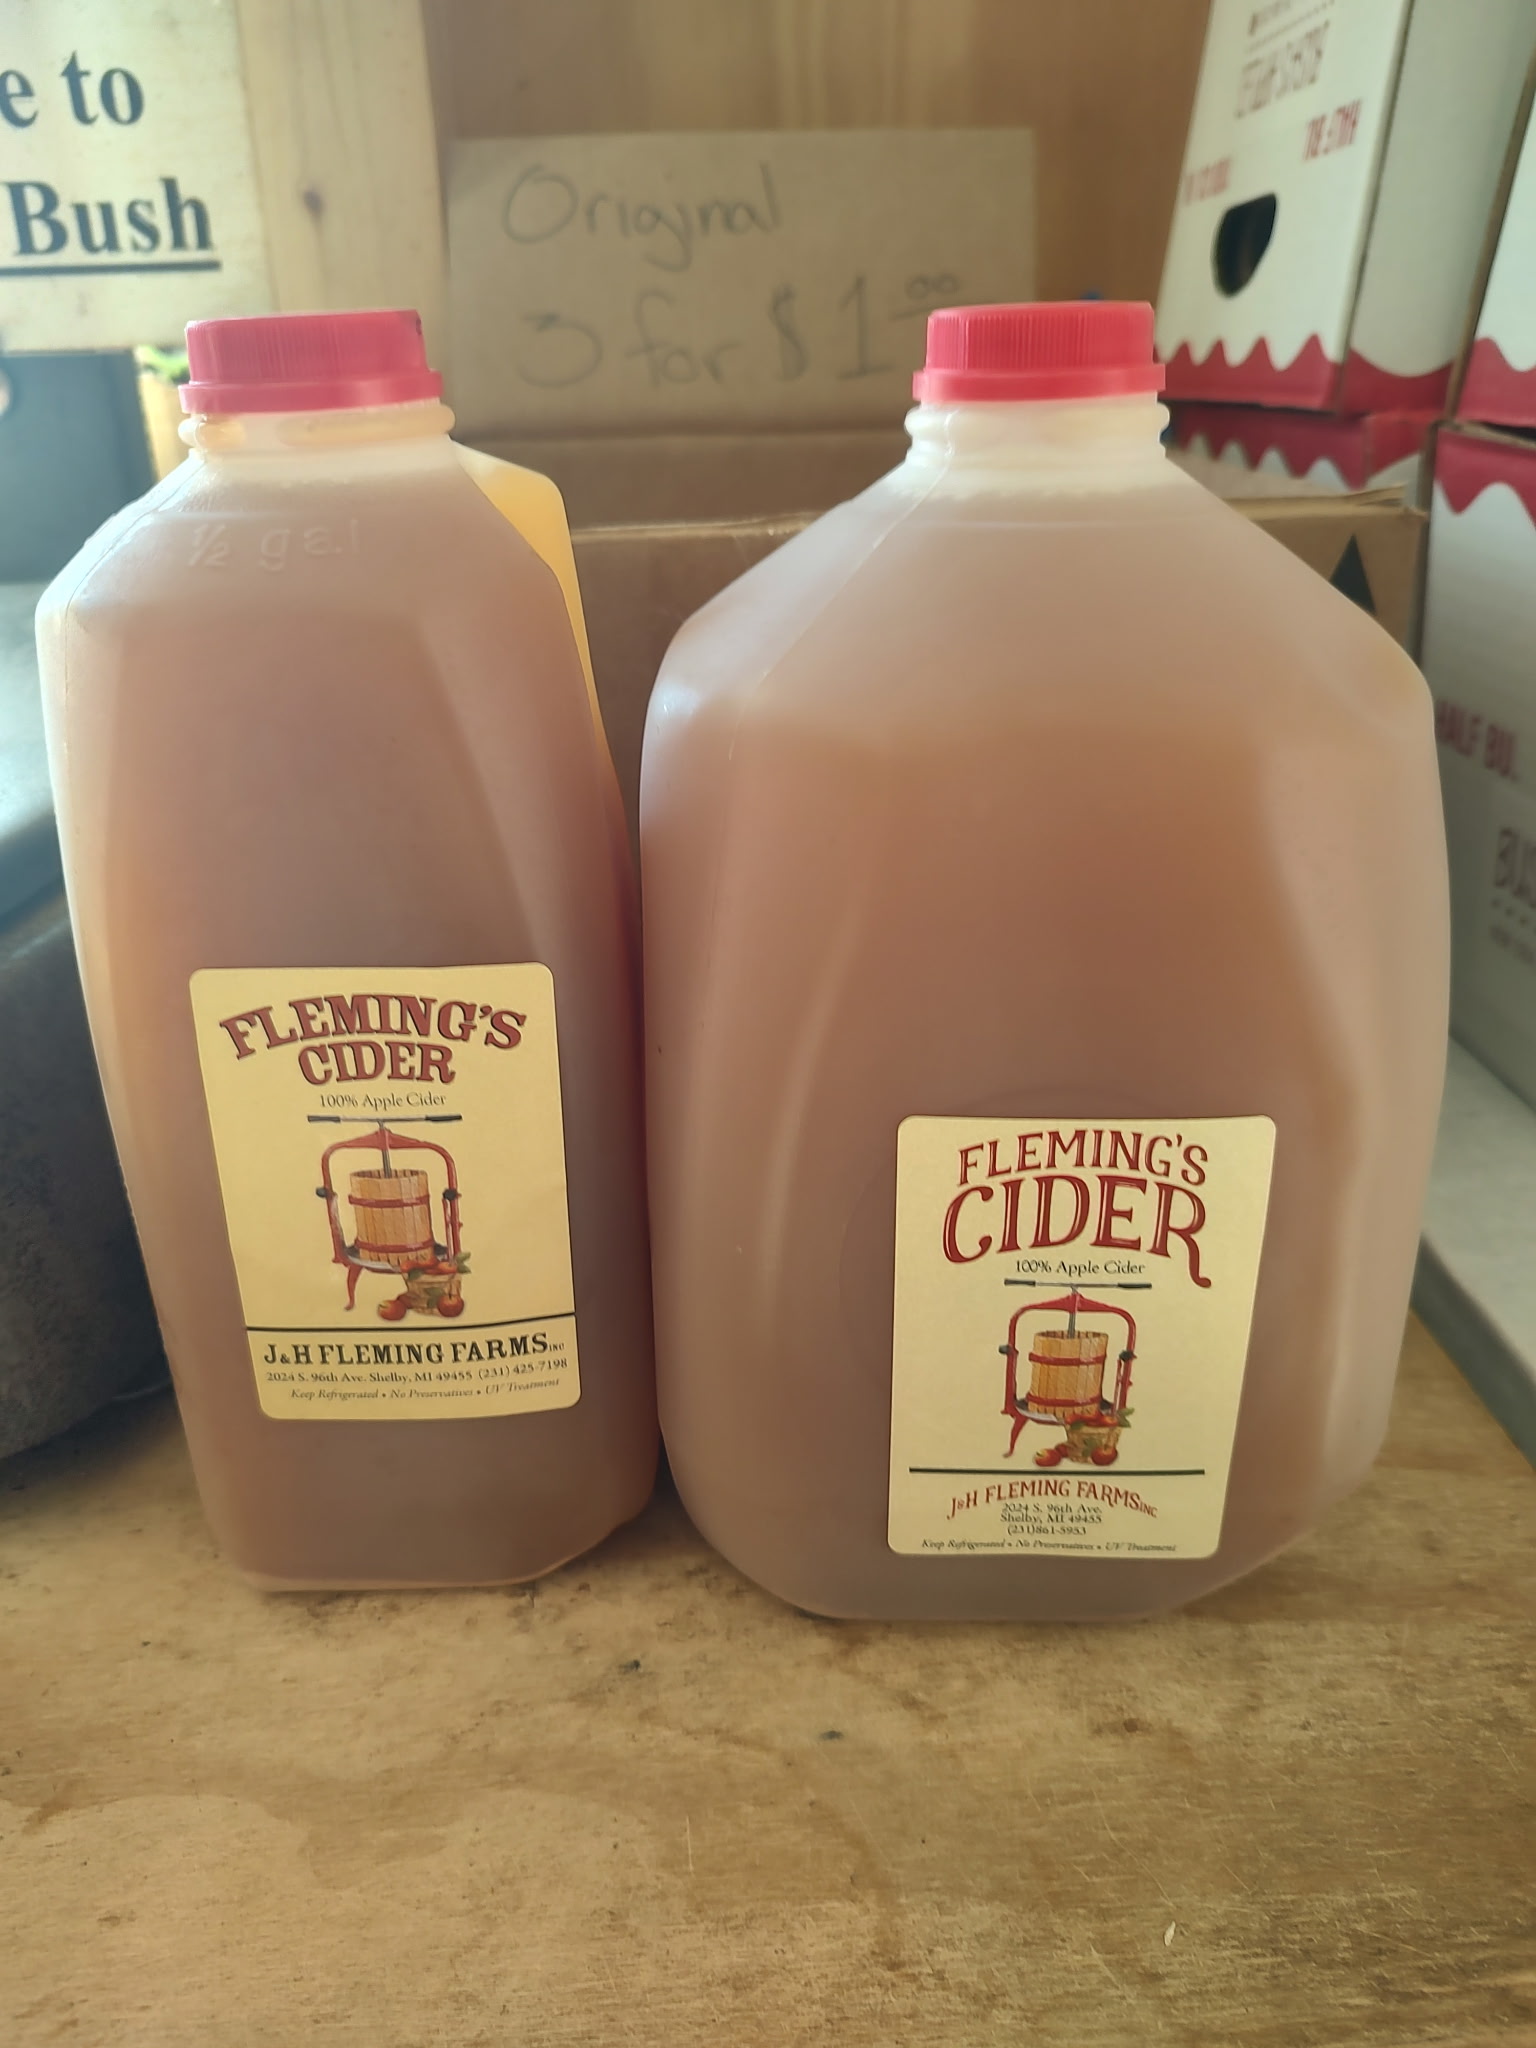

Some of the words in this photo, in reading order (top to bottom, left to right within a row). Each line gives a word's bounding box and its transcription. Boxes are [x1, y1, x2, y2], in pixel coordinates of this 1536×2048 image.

[61, 51, 144, 126] to
[4, 177, 213, 256] Bush
[516, 310, 602, 388] 3
[625, 288, 742, 387] for
[219, 993, 527, 1060] FLEMING'S
[298, 1040, 456, 1085] CIDER
[320, 1093, 359, 1108] 100%
[362, 1092, 403, 1111] Apple
[406, 1091, 447, 1107] Cider
[957, 1129, 1209, 1186] FLEMING'S
[942, 1174, 1213, 1289] CIDER
[1016, 1259, 1052, 1273] 100%
[1056, 1259, 1100, 1278] Apple
[1103, 1259, 1146, 1274] Cider
[317, 1342, 443, 1365] FLEMING
[266, 1371, 295, 1382] 2024
[311, 1371, 338, 1382] 96th
[369, 1371, 412, 1384] Shelby,
[415, 1372, 432, 1382] MI
[436, 1370, 473, 1382] 49455
[290, 1388, 315, 1400] Keep
[318, 1387, 379, 1401] Refrigerated
[390, 1388, 406, 1398] No
[985, 1479, 1070, 1504] FLEMING
[1002, 1503, 1029, 1513] 2024
